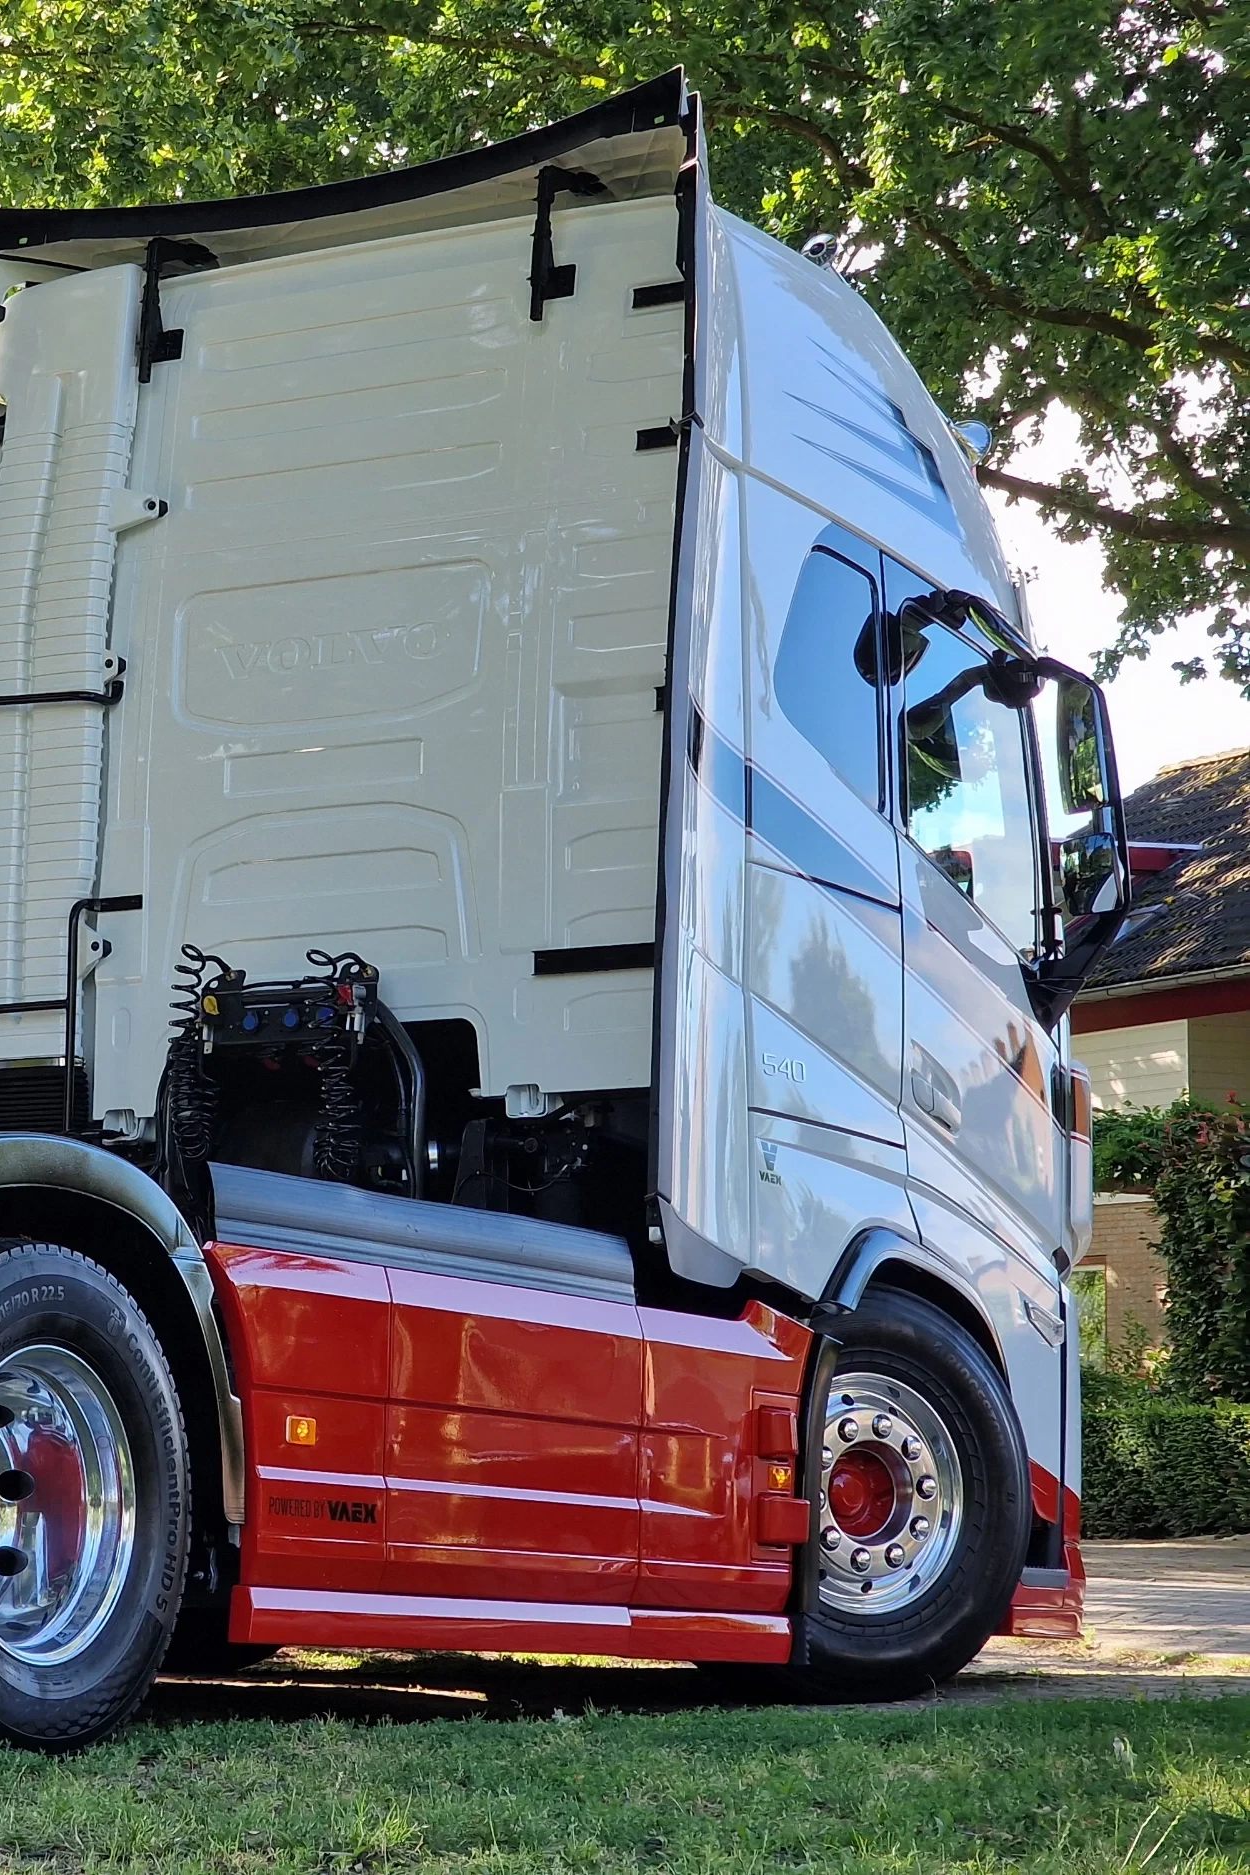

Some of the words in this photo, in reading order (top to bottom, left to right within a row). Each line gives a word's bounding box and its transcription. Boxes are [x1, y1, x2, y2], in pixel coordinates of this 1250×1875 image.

[214, 620, 443, 680] VOLVO
[762, 1052, 807, 1083] 540
[759, 1170, 782, 1186] VAEX
[31, 1288, 41, 1304] R
[41, 1286, 65, 1301] 22.5
[128, 1333, 160, 1393] Conti
[153, 1391, 181, 1547] EfficientPro
[269, 1497, 310, 1518] POWERED
[314, 1501, 326, 1518] BY
[327, 1500, 377, 1524] VAEX
[160, 1552, 177, 1591] HD
[156, 1594, 168, 1613] 5
